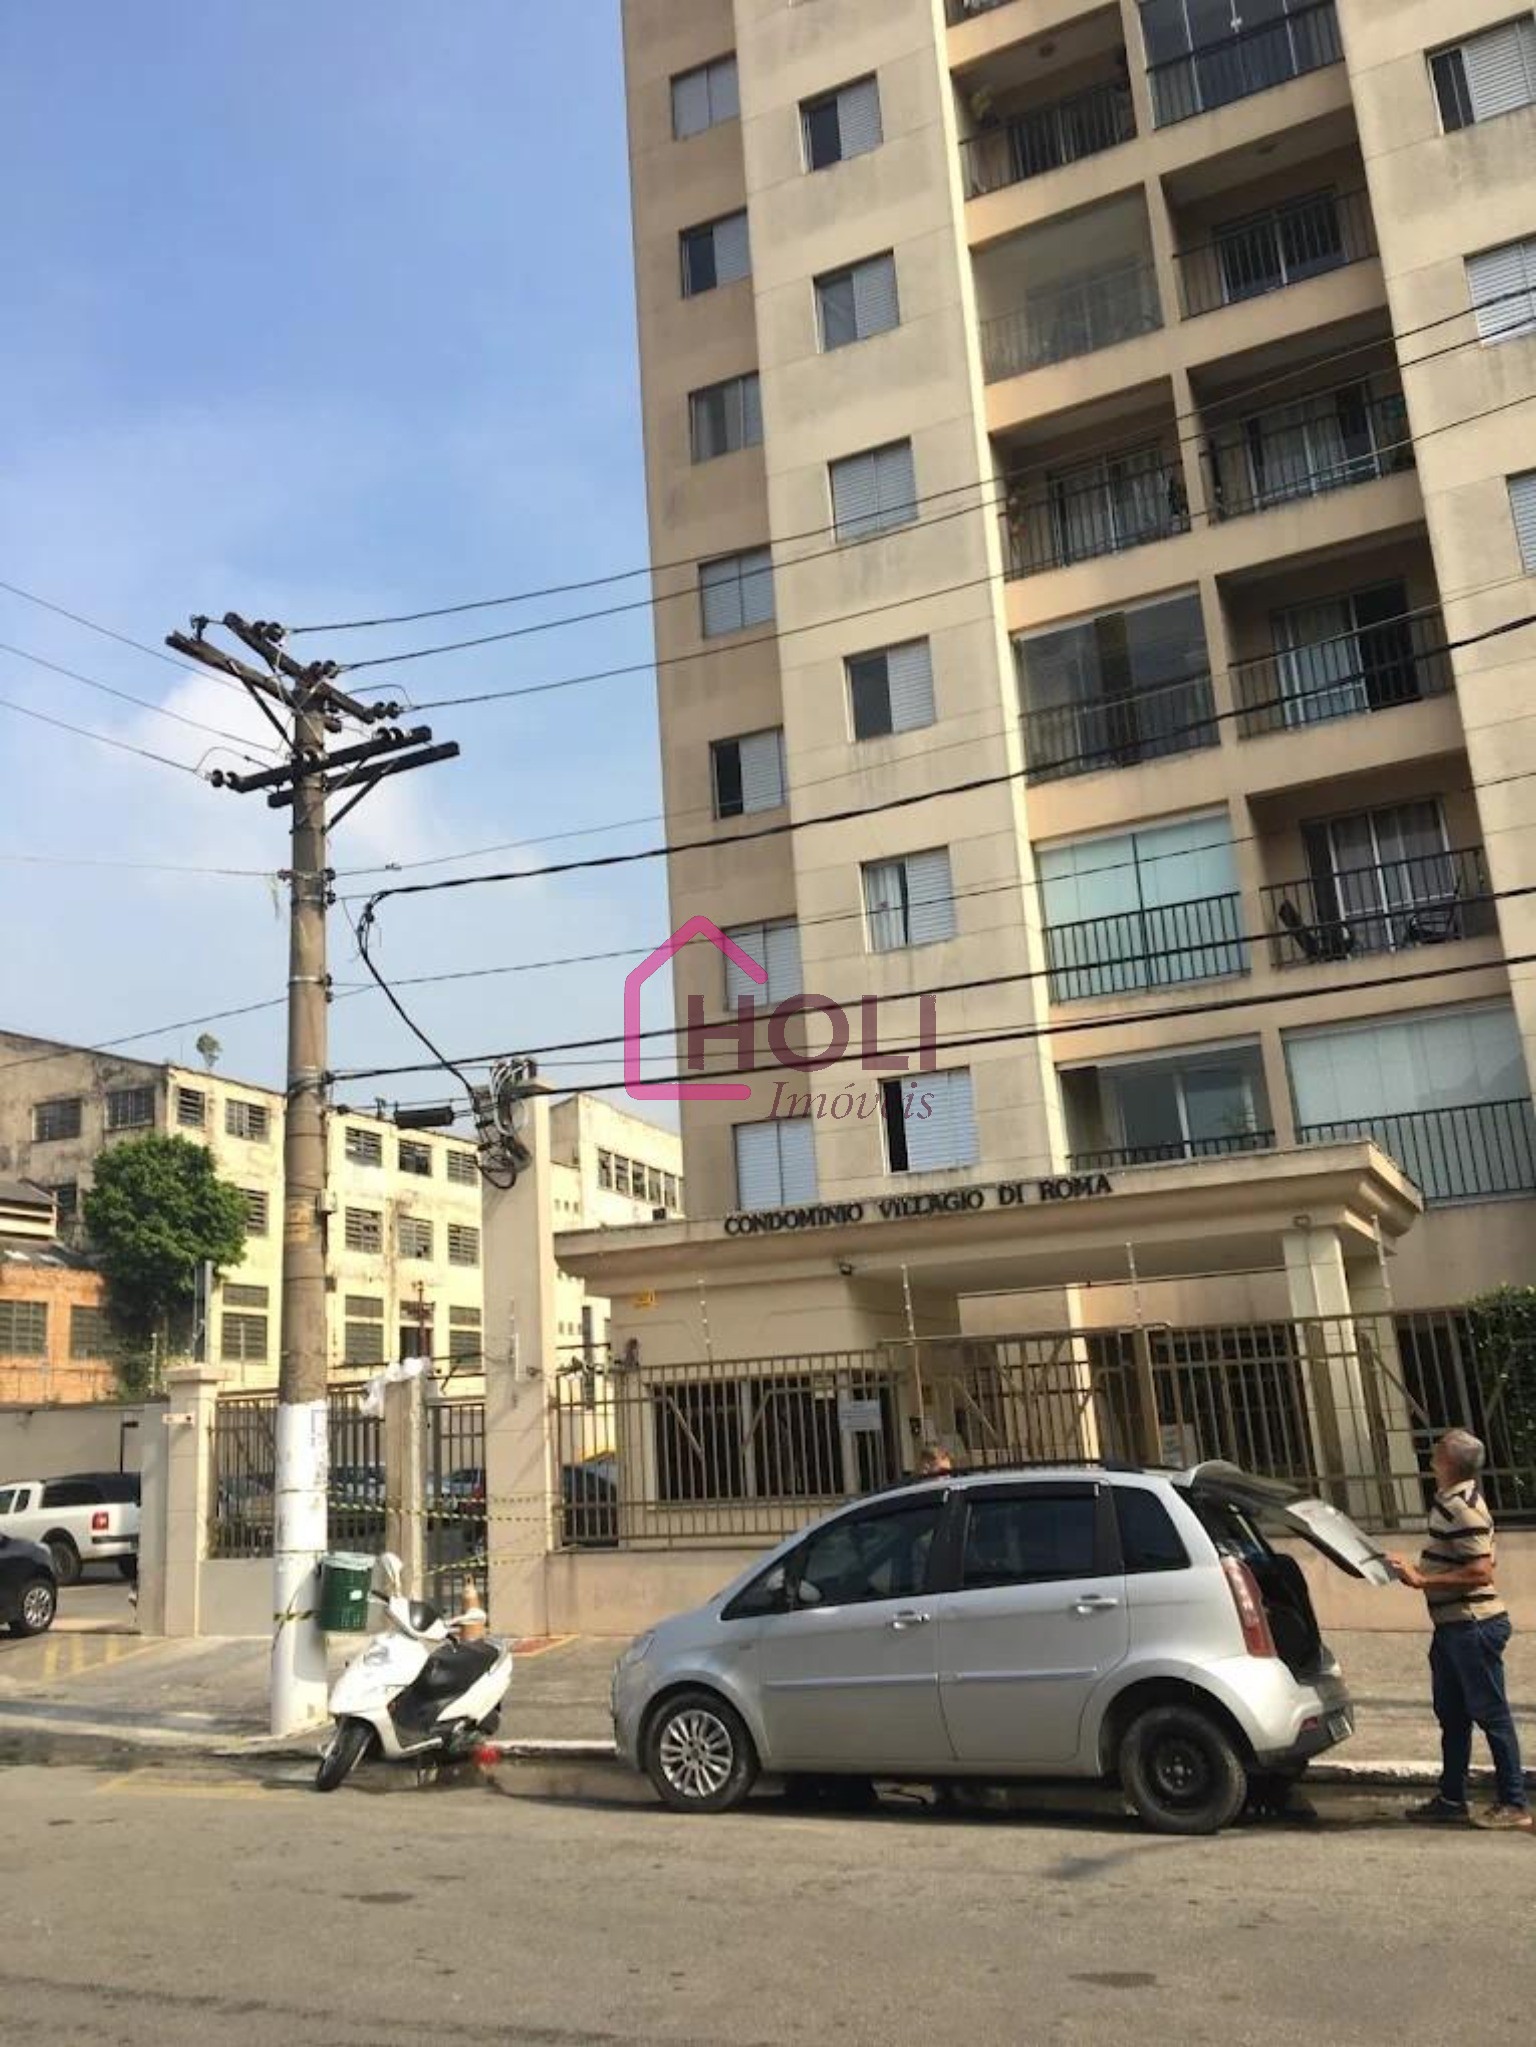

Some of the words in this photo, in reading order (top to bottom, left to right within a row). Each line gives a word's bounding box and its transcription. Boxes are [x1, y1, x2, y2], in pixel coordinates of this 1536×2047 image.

[724, 1203, 863, 1235] CONDOMINIO
[878, 1189, 984, 1218] VILLAGIO
[998, 1184, 1024, 1206] DI
[1040, 1174, 1112, 1200] ROMA
